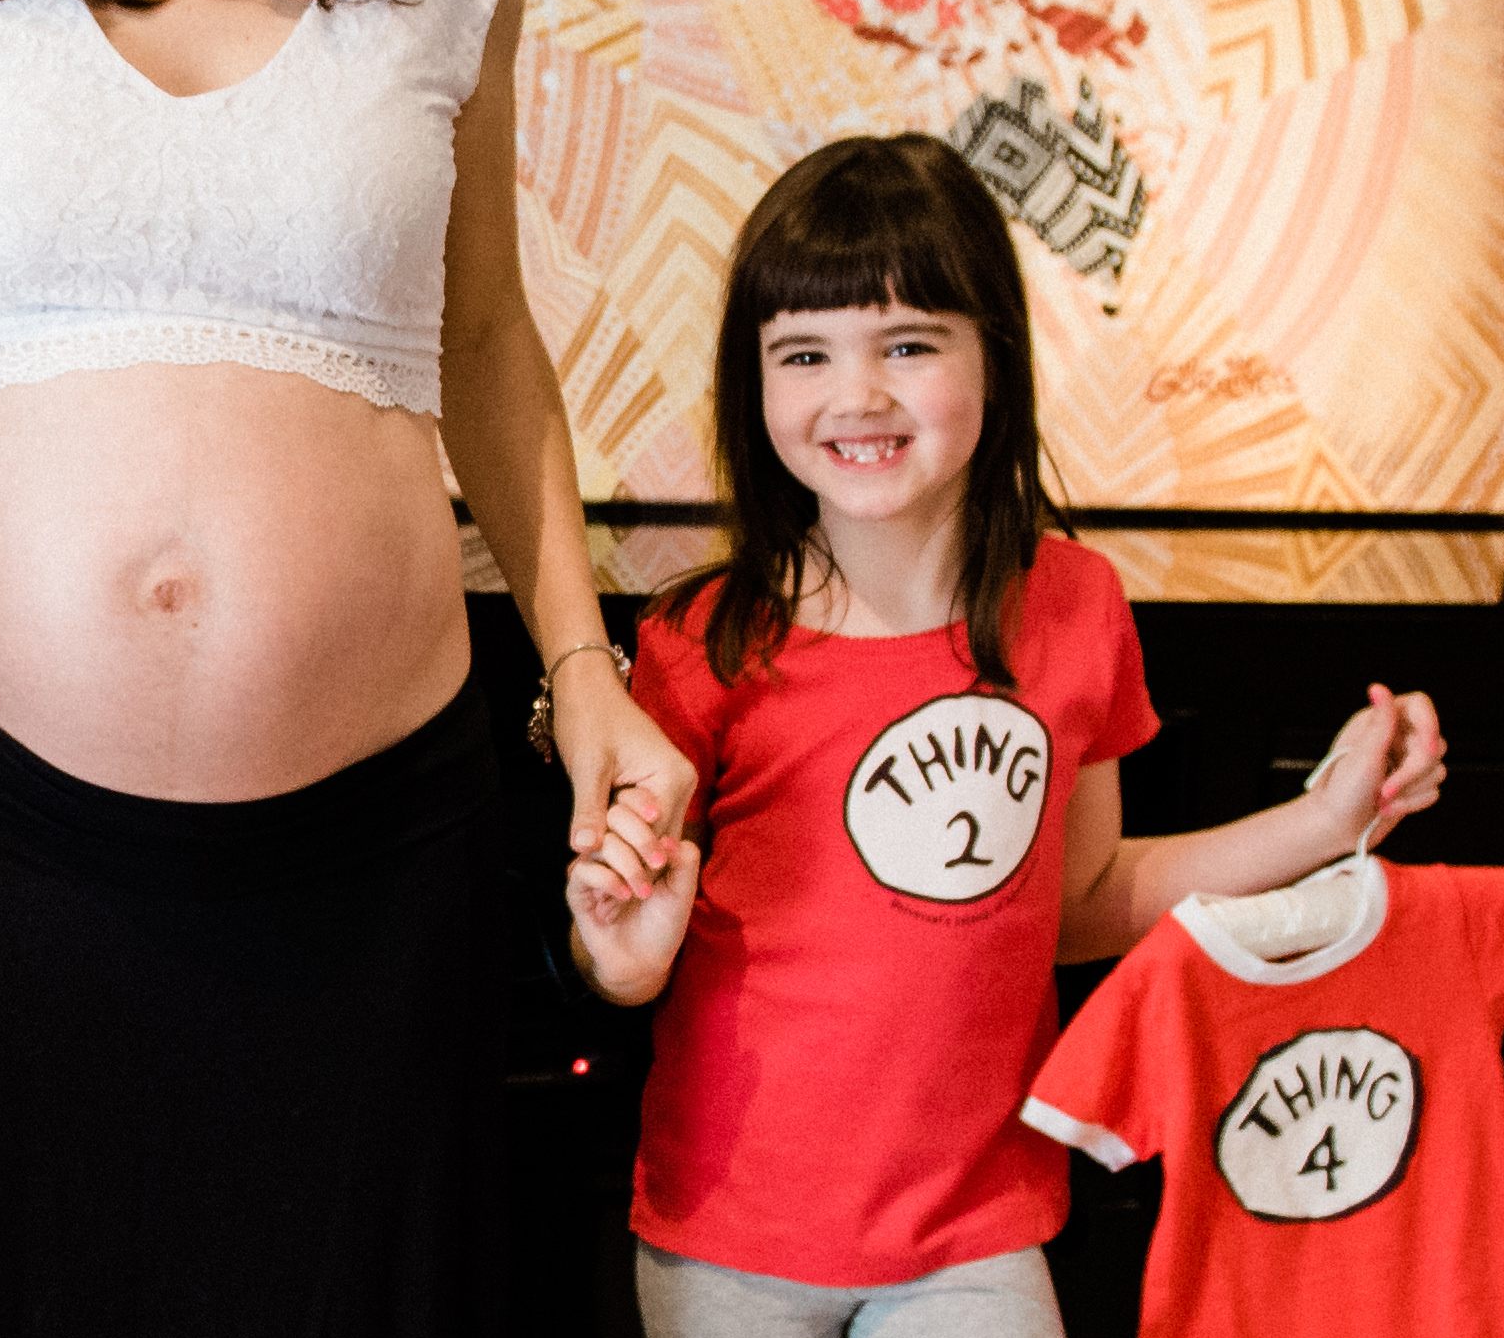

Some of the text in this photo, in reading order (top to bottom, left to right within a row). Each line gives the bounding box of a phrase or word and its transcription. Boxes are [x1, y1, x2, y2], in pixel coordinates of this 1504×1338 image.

[864, 722, 1040, 805] THING
[944, 810, 994, 869] 2
[1239, 1054, 1401, 1140] THING
[1298, 1125, 1347, 1192] 4
